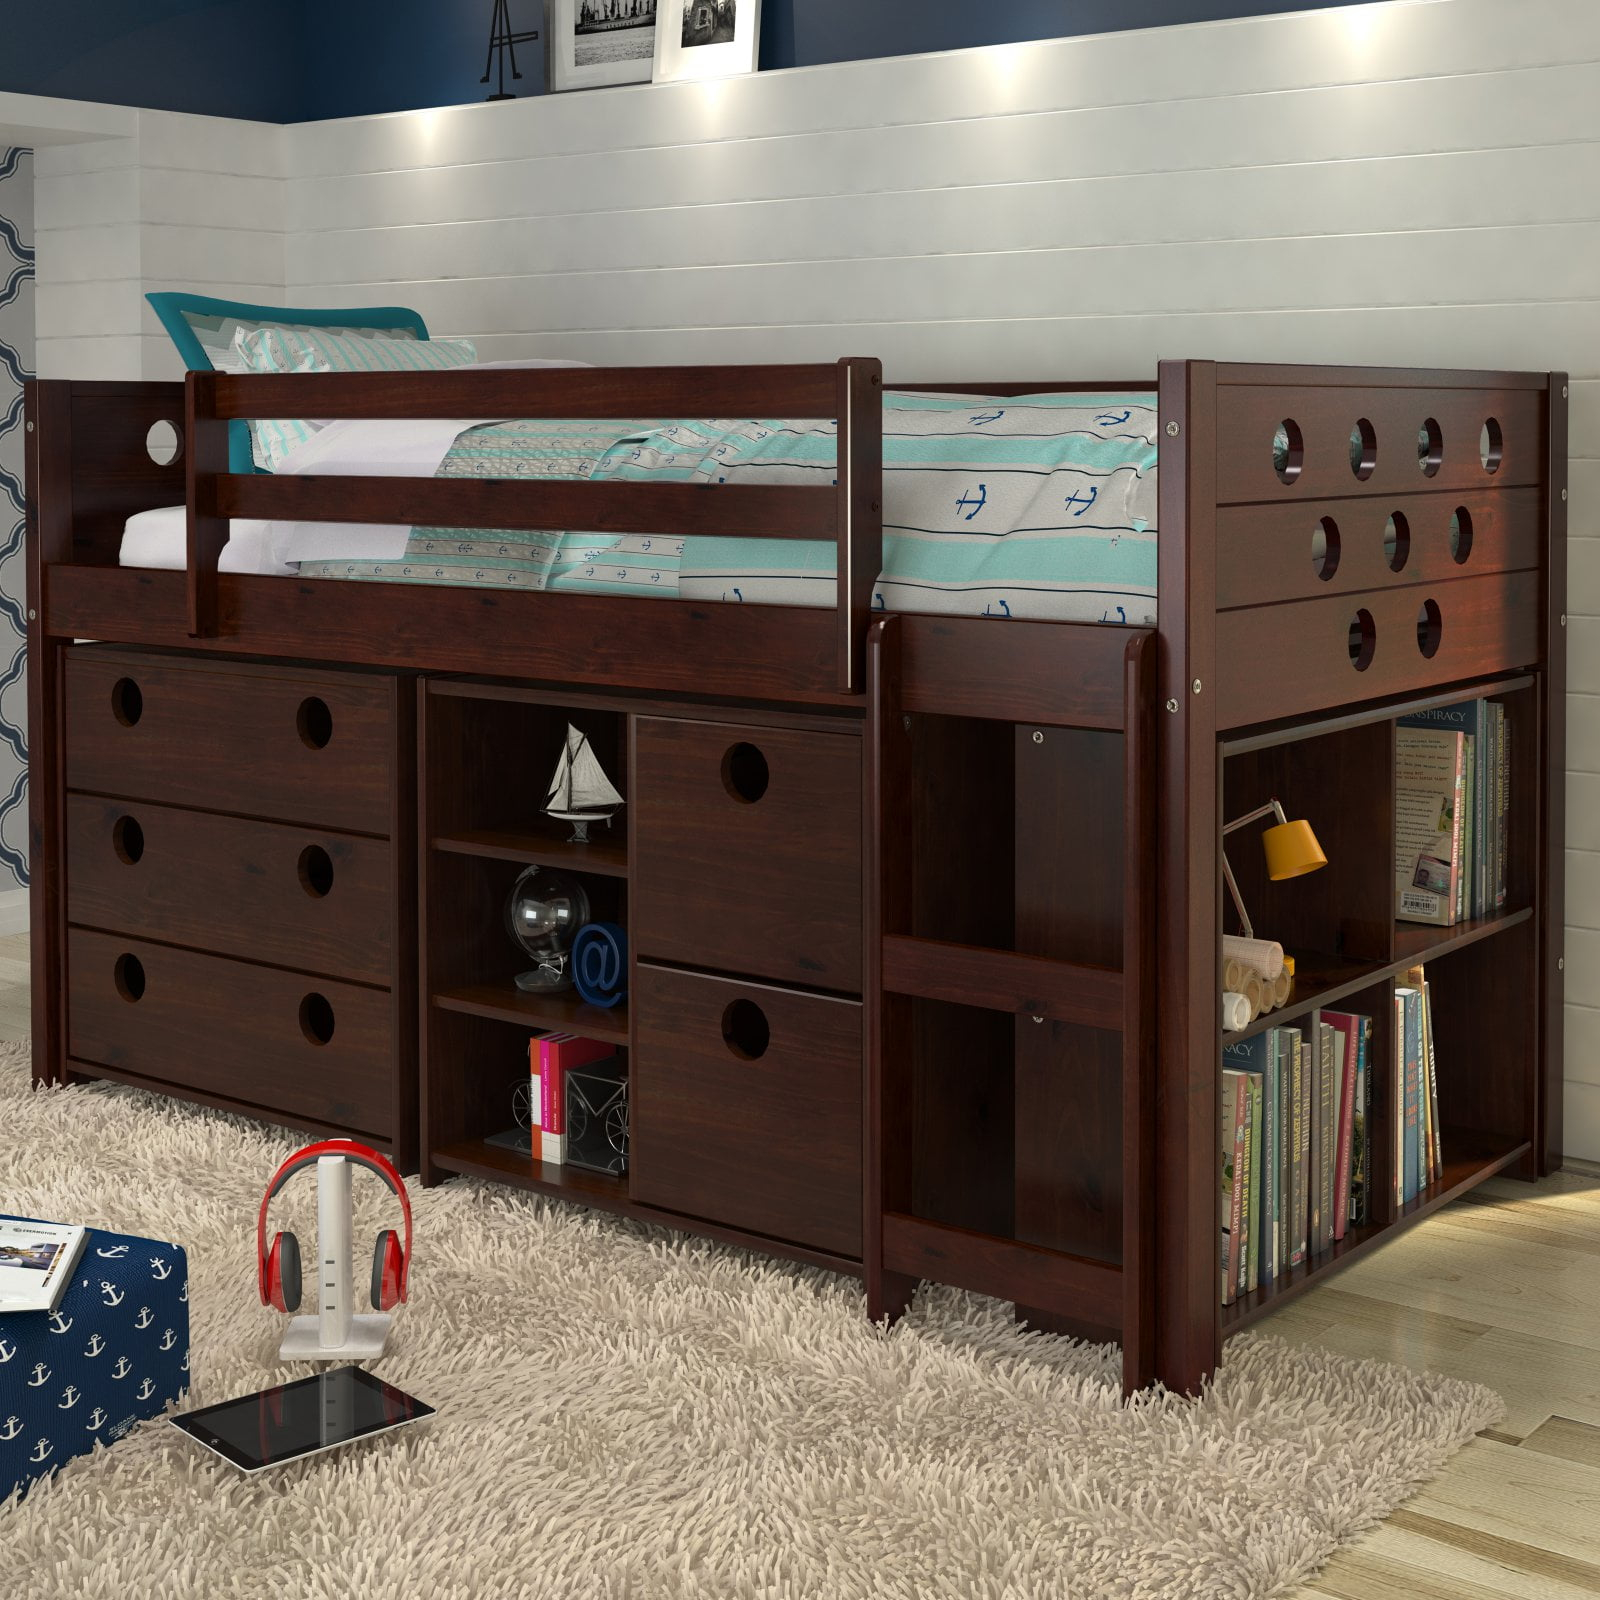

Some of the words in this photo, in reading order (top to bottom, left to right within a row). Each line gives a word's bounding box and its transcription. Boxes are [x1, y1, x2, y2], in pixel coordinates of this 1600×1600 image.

[1459, 818, 1465, 828] OF
[1293, 1035, 1301, 1054] THE
[1293, 1054, 1301, 1100] PROPHECY
[1428, 1041, 1438, 1099] TRINITY
[1293, 1102, 1301, 1115] OF
[1242, 1128, 1251, 1172] DUNGEON
[1293, 1116, 1301, 1163] ZEPHYRUS
[1321, 1126, 1329, 1176] KIRSTEN
[1234, 1152, 1243, 1180] KEDAI
[1242, 1174, 1250, 1185] OF
[1233, 1182, 1241, 1202] 1001
[1241, 1187, 1250, 1218] DEATH
[1321, 1180, 1329, 1215] KELLY
[1231, 1204, 1240, 1234] MIMPI
[1239, 1245, 1248, 1266] Scott
